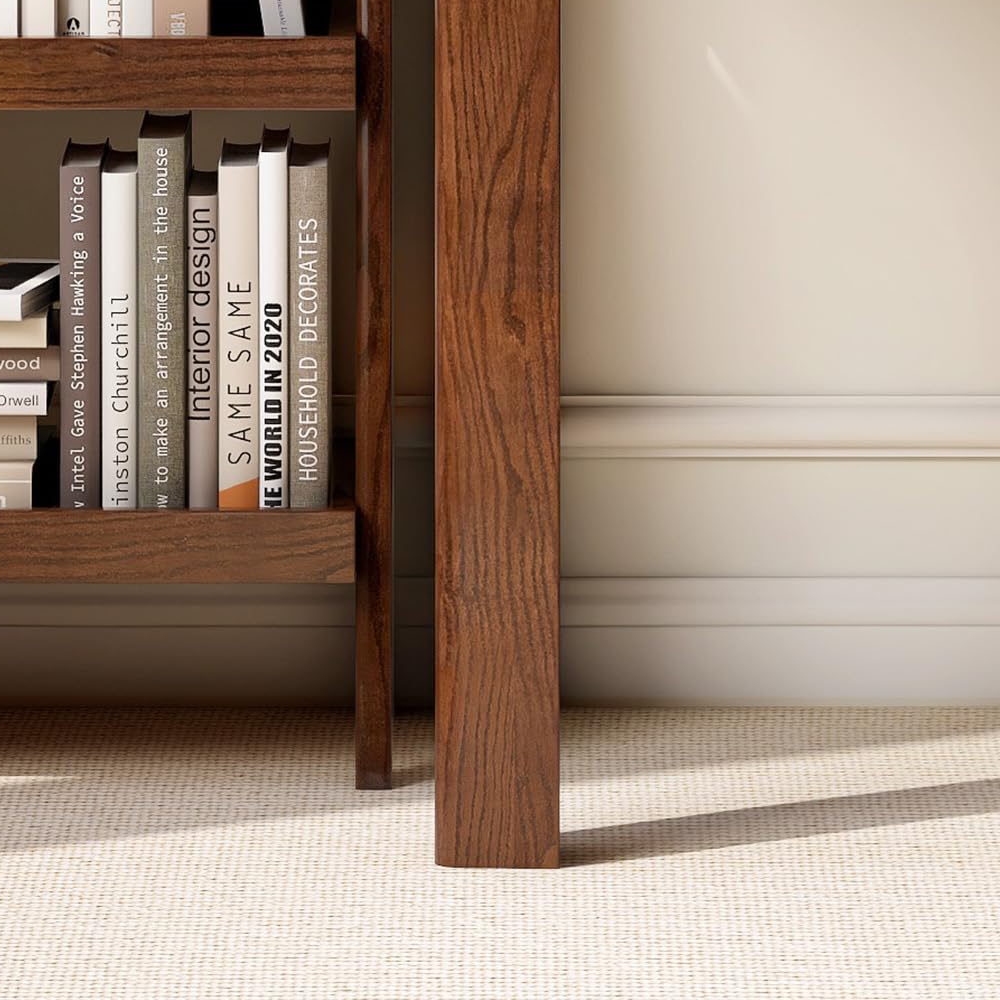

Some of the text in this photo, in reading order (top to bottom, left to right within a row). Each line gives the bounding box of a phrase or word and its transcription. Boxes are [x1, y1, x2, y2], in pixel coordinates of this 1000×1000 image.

[152, 147, 168, 197] house
[70, 176, 84, 223] Voice
[153, 206, 168, 235] the
[73, 232, 84, 242] a
[152, 246, 168, 264] in
[70, 250, 88, 316] Hawking
[154, 274, 172, 379] arrangement
[188, 208, 216, 420] Interior design
[264, 303, 282, 363] 2020
[71, 324, 88, 390] Stephen
[111, 294, 128, 412] Churchill
[228, 281, 251, 464] SAME SAME
[298, 218, 318, 481] HOUSEHOLD DECORATES
[157, 388, 168, 408] an
[264, 370, 282, 392] IN
[71, 400, 85, 437] Gave
[153, 418, 168, 458] make
[264, 399, 282, 481] WORLD
[71, 446, 85, 492] Intel
[155, 466, 168, 485] to
